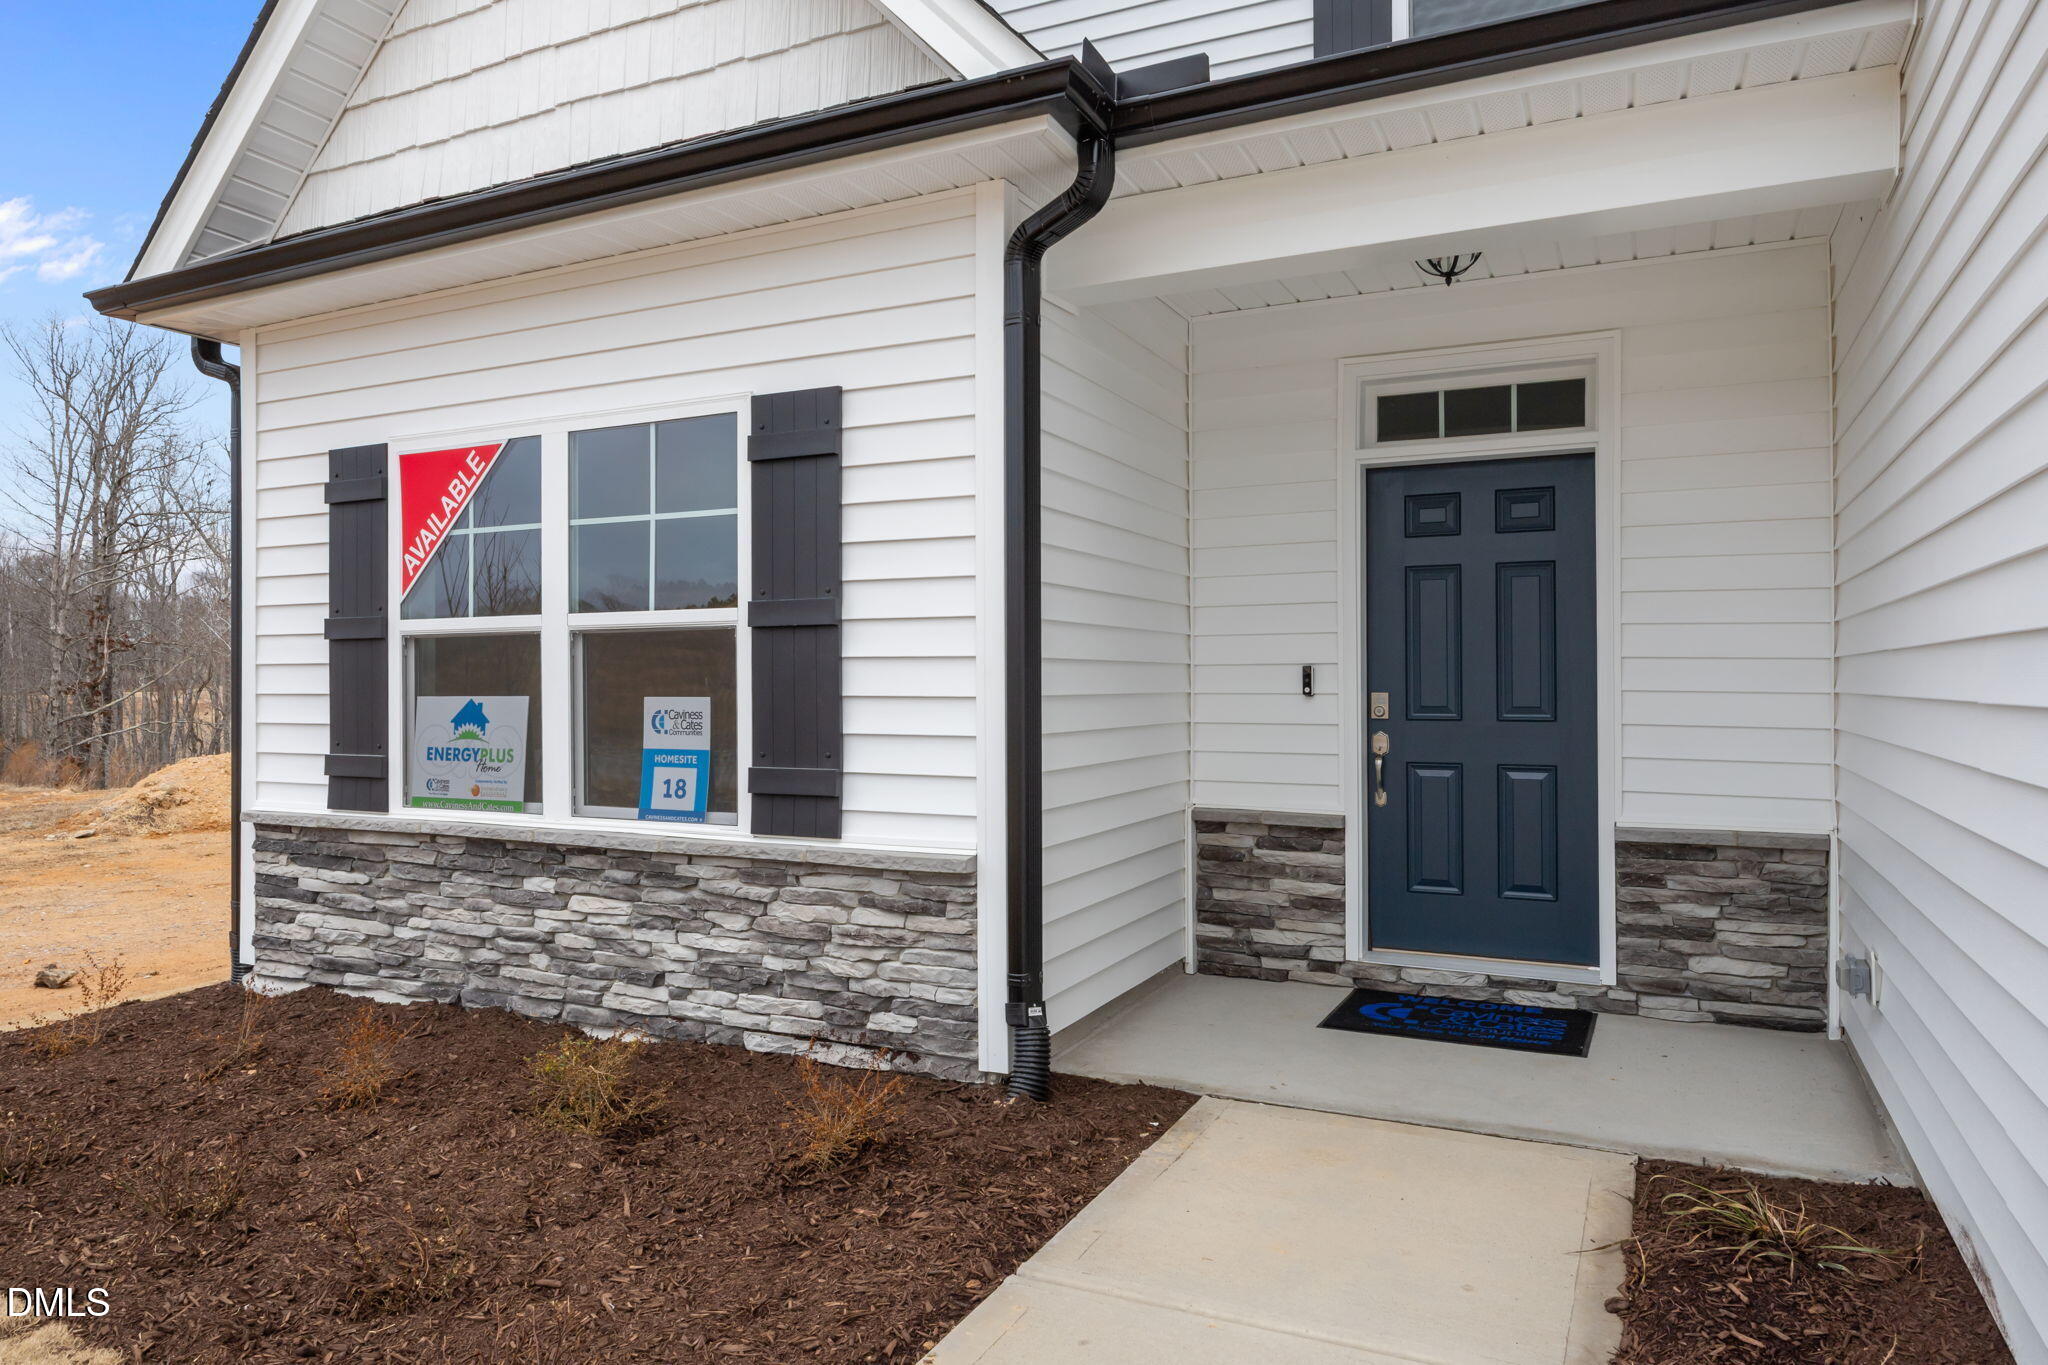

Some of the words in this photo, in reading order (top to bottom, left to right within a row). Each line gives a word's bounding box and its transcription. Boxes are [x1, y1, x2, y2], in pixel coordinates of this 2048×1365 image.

[403, 449, 486, 576] AVAILABLE
[668, 709, 704, 720] Caviness
[672, 720, 680, 730] &
[680, 719, 703, 731] Cates
[475, 759, 502, 773] Home
[654, 754, 698, 765] HOMESITE
[662, 778, 687, 800] 18
[422, 799, 514, 812] www.CavinessAndCates.com
[1398, 994, 1544, 1014] WELCOME
[1429, 1007, 1568, 1028] Caviness
[1473, 1018, 1565, 1035] Cates
